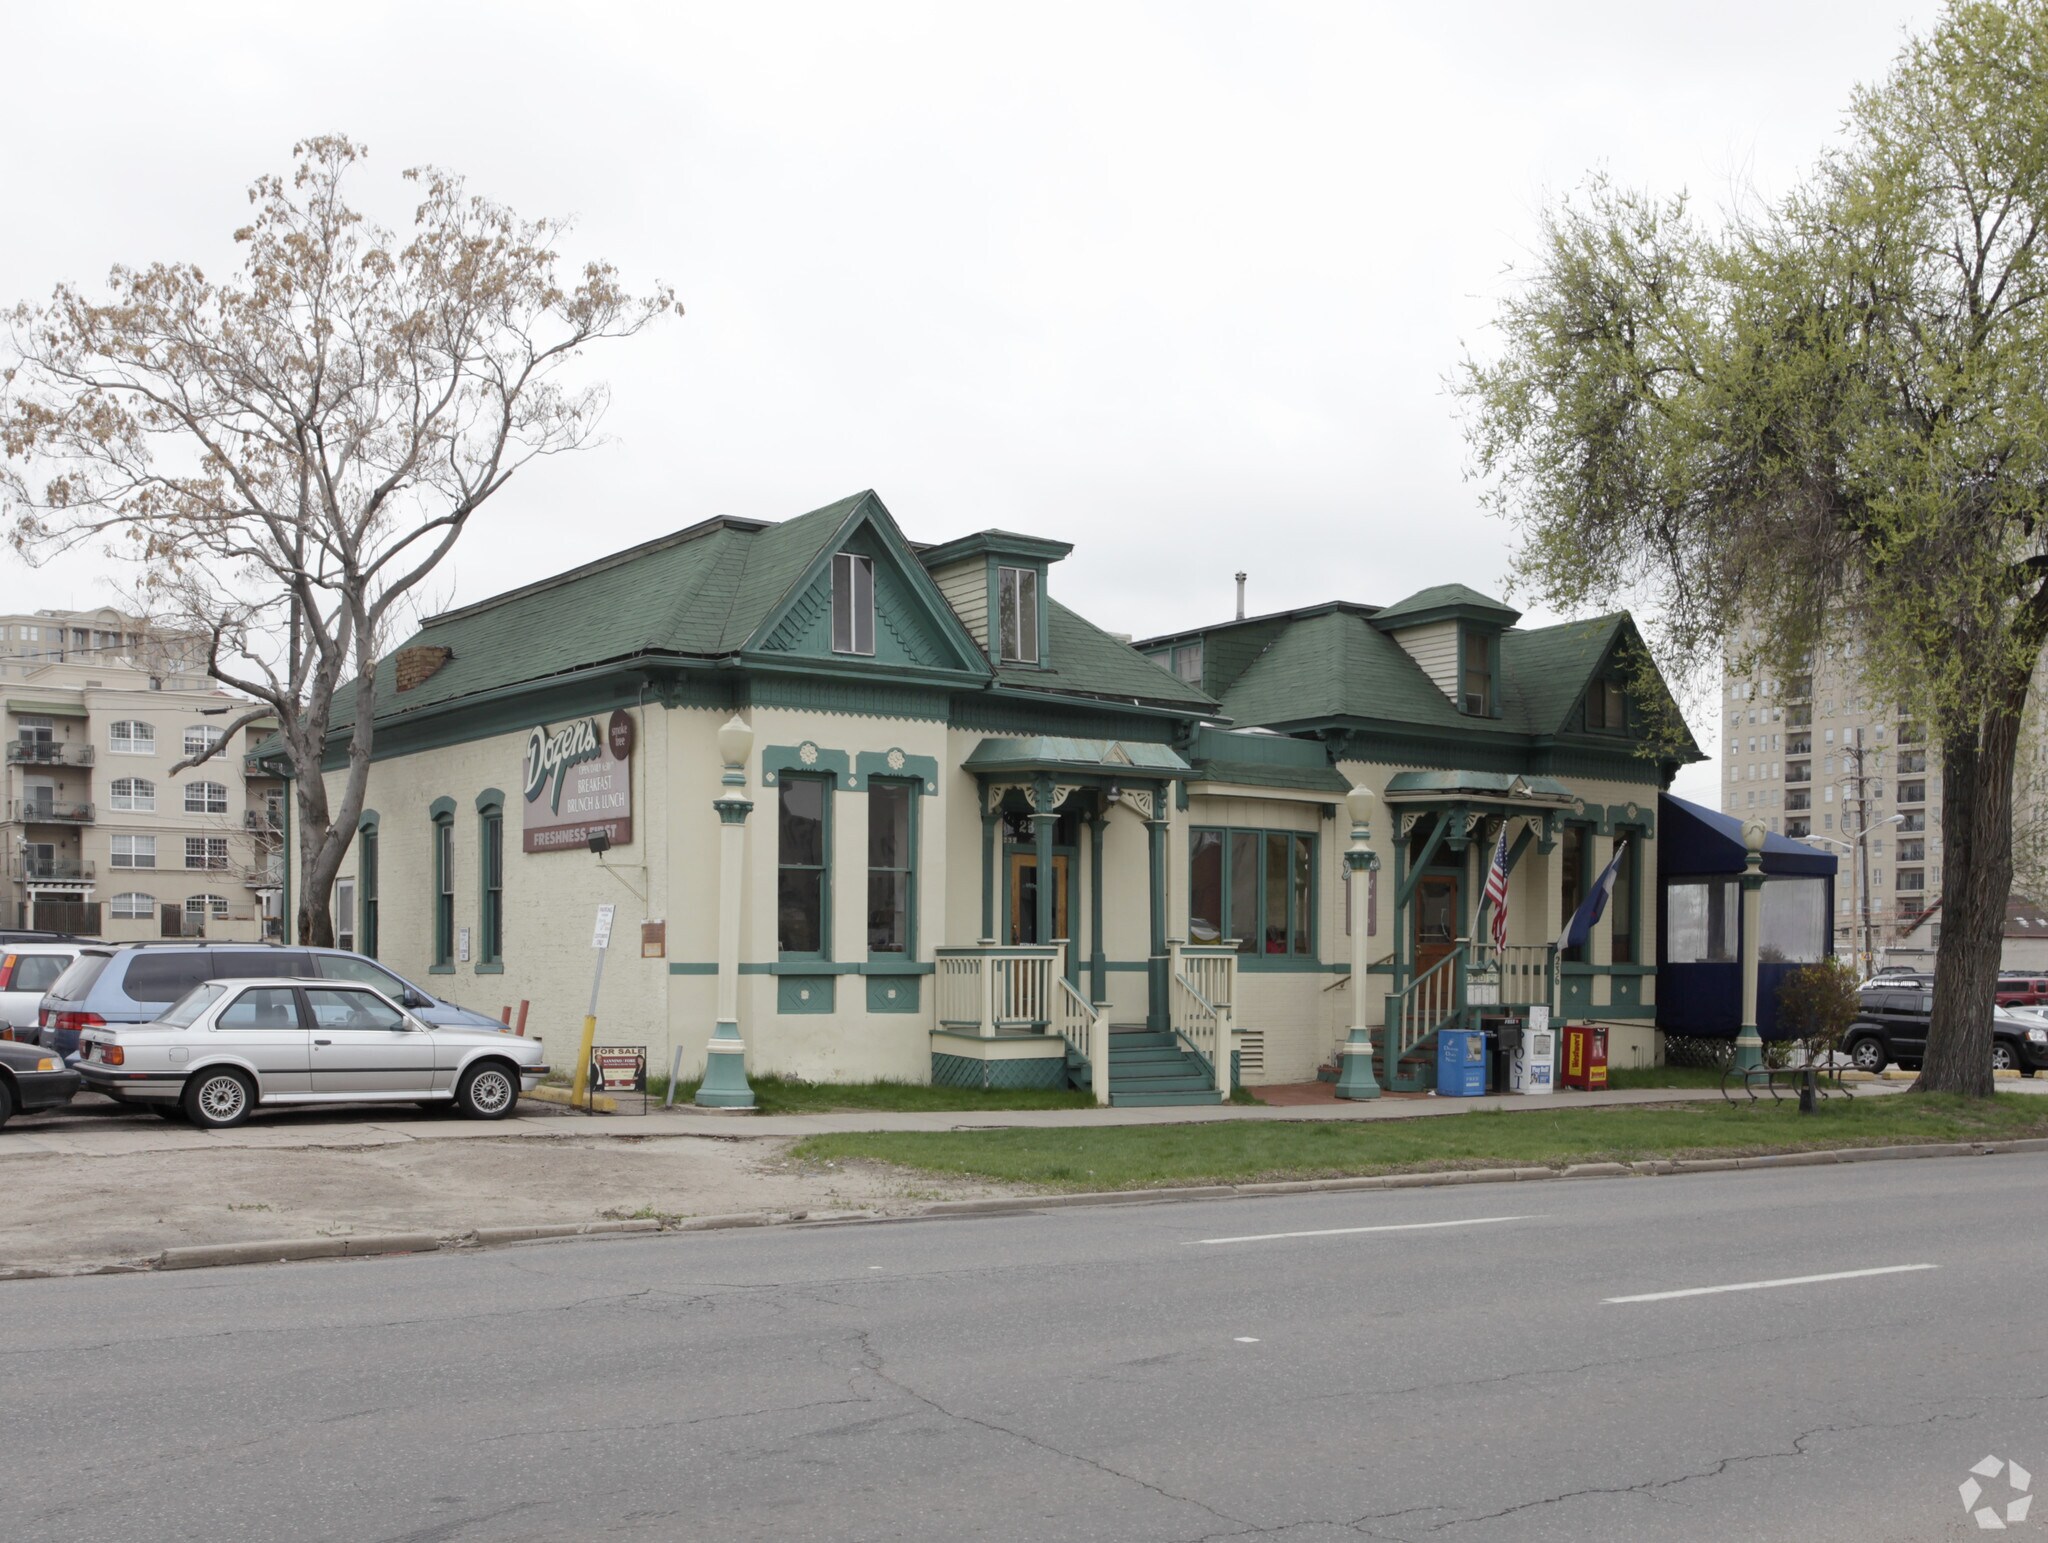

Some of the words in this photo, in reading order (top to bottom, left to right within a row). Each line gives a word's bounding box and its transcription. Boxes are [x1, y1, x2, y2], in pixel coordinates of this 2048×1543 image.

[611, 723, 628, 736] smoke
[615, 735, 626, 746] free
[524, 717, 600, 814] Dozens
[578, 775, 612, 793] BREAKFAST
[567, 795, 594, 814] BRUNCH
[594, 795, 601, 810] &
[601, 792, 625, 809] LUNCH
[1019, 820, 1036, 834] 23
[534, 827, 587, 846] FRESHNESS
